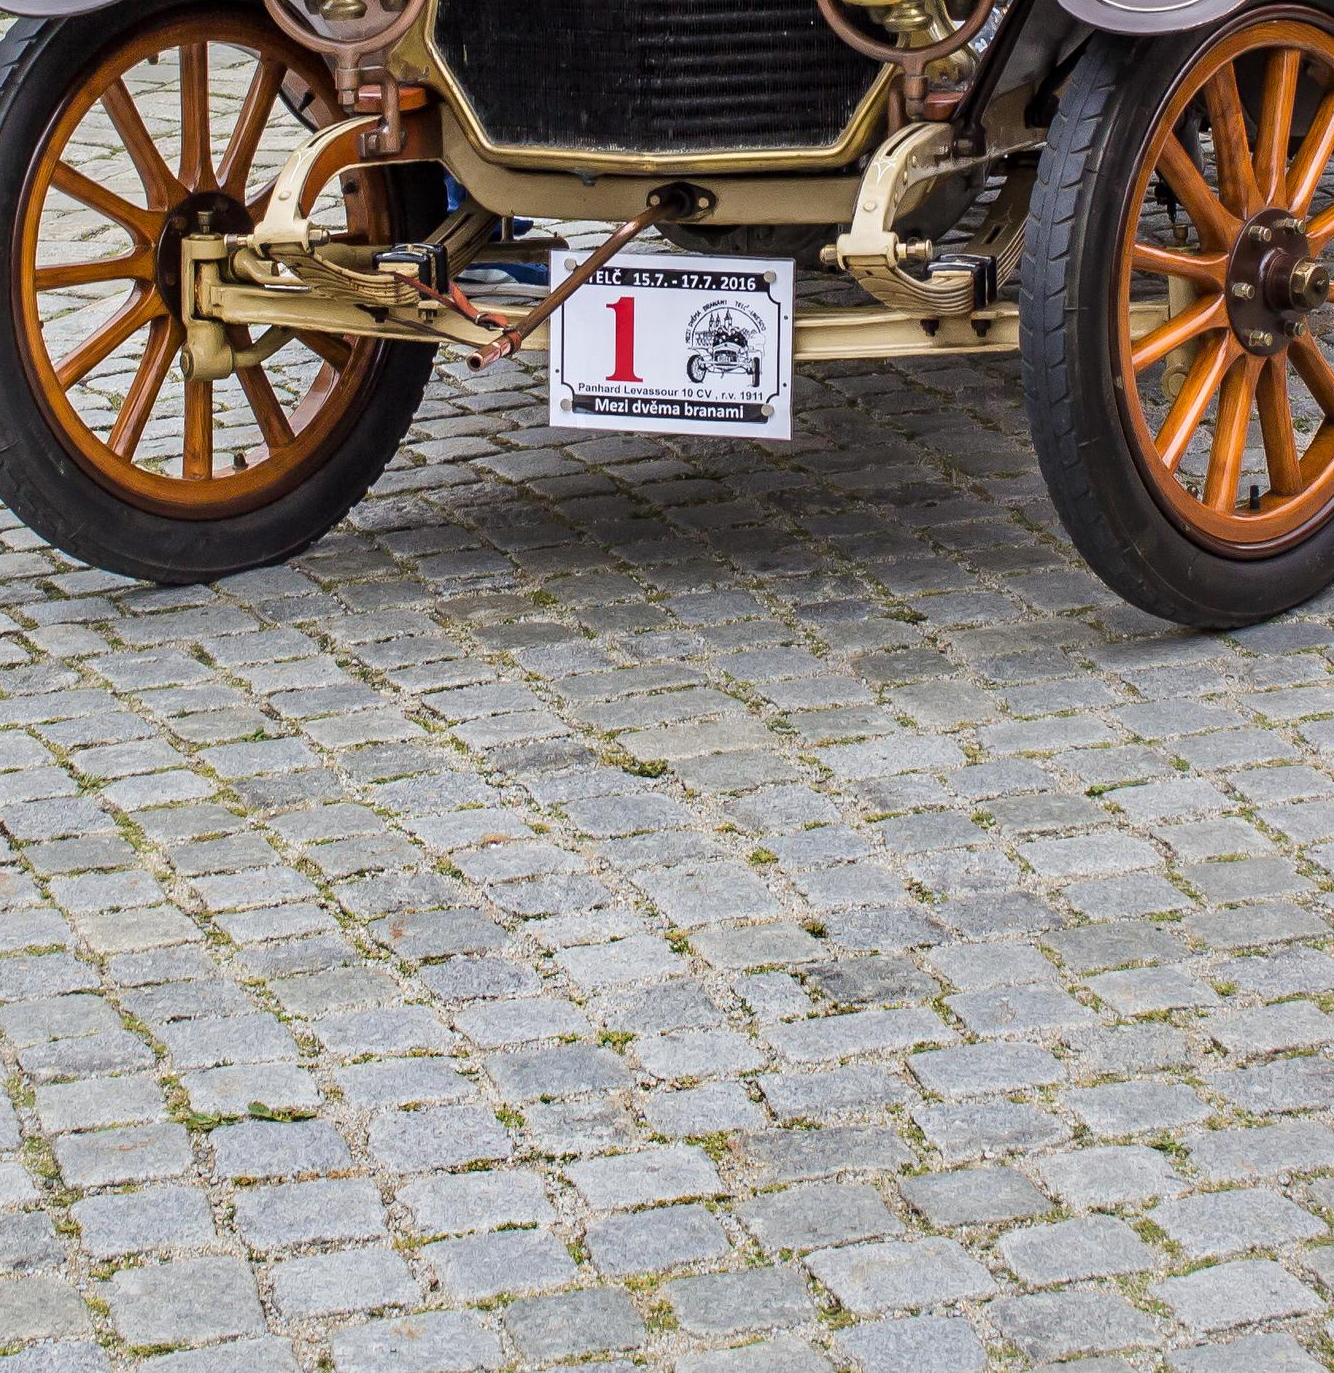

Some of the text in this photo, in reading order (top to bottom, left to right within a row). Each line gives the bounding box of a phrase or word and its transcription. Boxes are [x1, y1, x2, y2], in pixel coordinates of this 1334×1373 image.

[633, 272, 668, 288] 15.7.
[682, 275, 717, 289] 17.7.
[720, 276, 756, 291] 2016
[605, 296, 644, 383] 1
[578, 382, 621, 394] Panhard
[624, 386, 679, 397] Levassour
[682, 388, 694, 398] 10
[696, 389, 712, 398] CV
[721, 392, 736, 400] r.v.
[740, 391, 763, 401] 1911
[594, 398, 744, 419] Mezi dvěma branami
